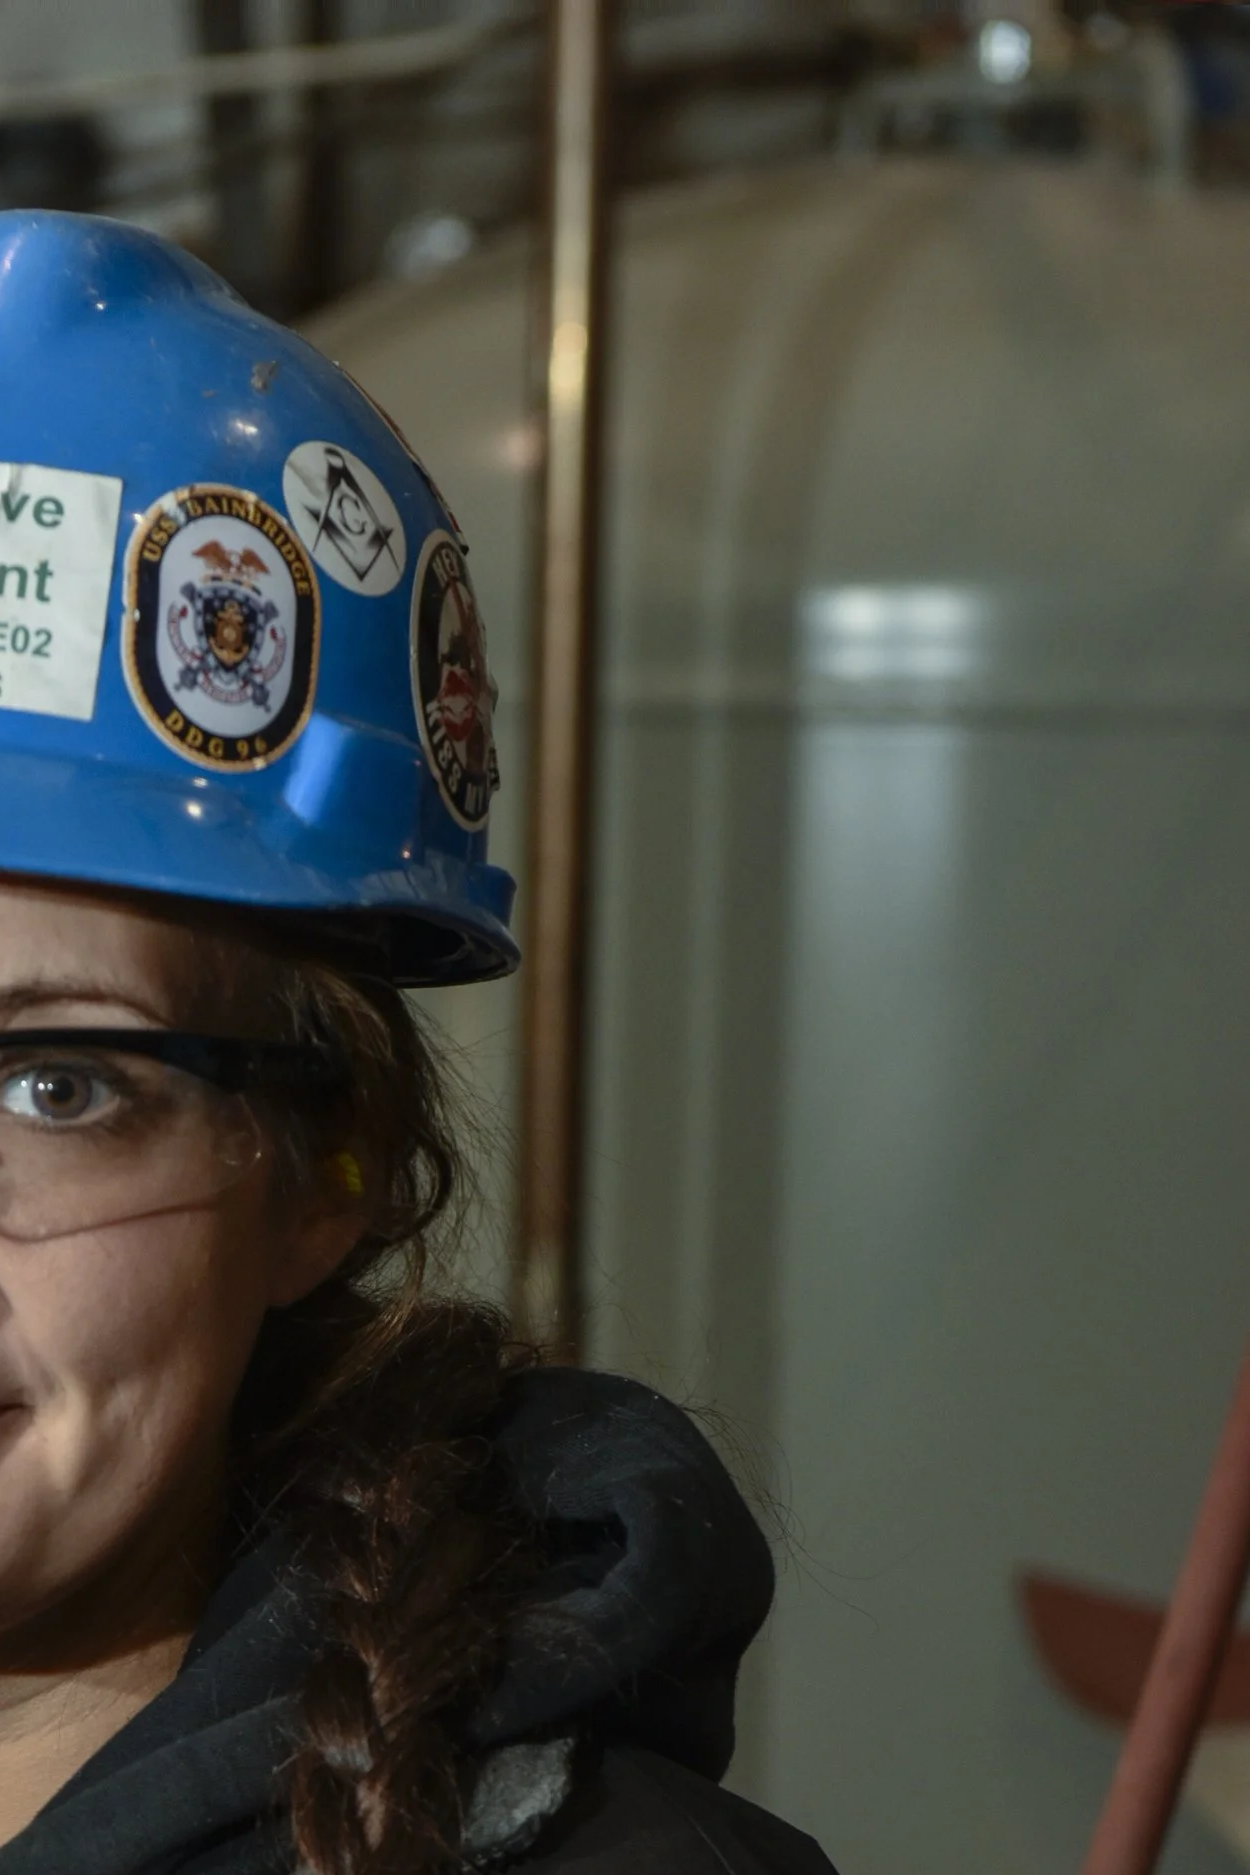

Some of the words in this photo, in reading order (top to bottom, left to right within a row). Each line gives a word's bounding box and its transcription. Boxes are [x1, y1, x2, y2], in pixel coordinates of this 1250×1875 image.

[142, 516, 177, 562] USS
[186, 496, 310, 596] BAINBRIDGE
[166, 709, 224, 760] DDG
[236, 735, 267, 759] 96
